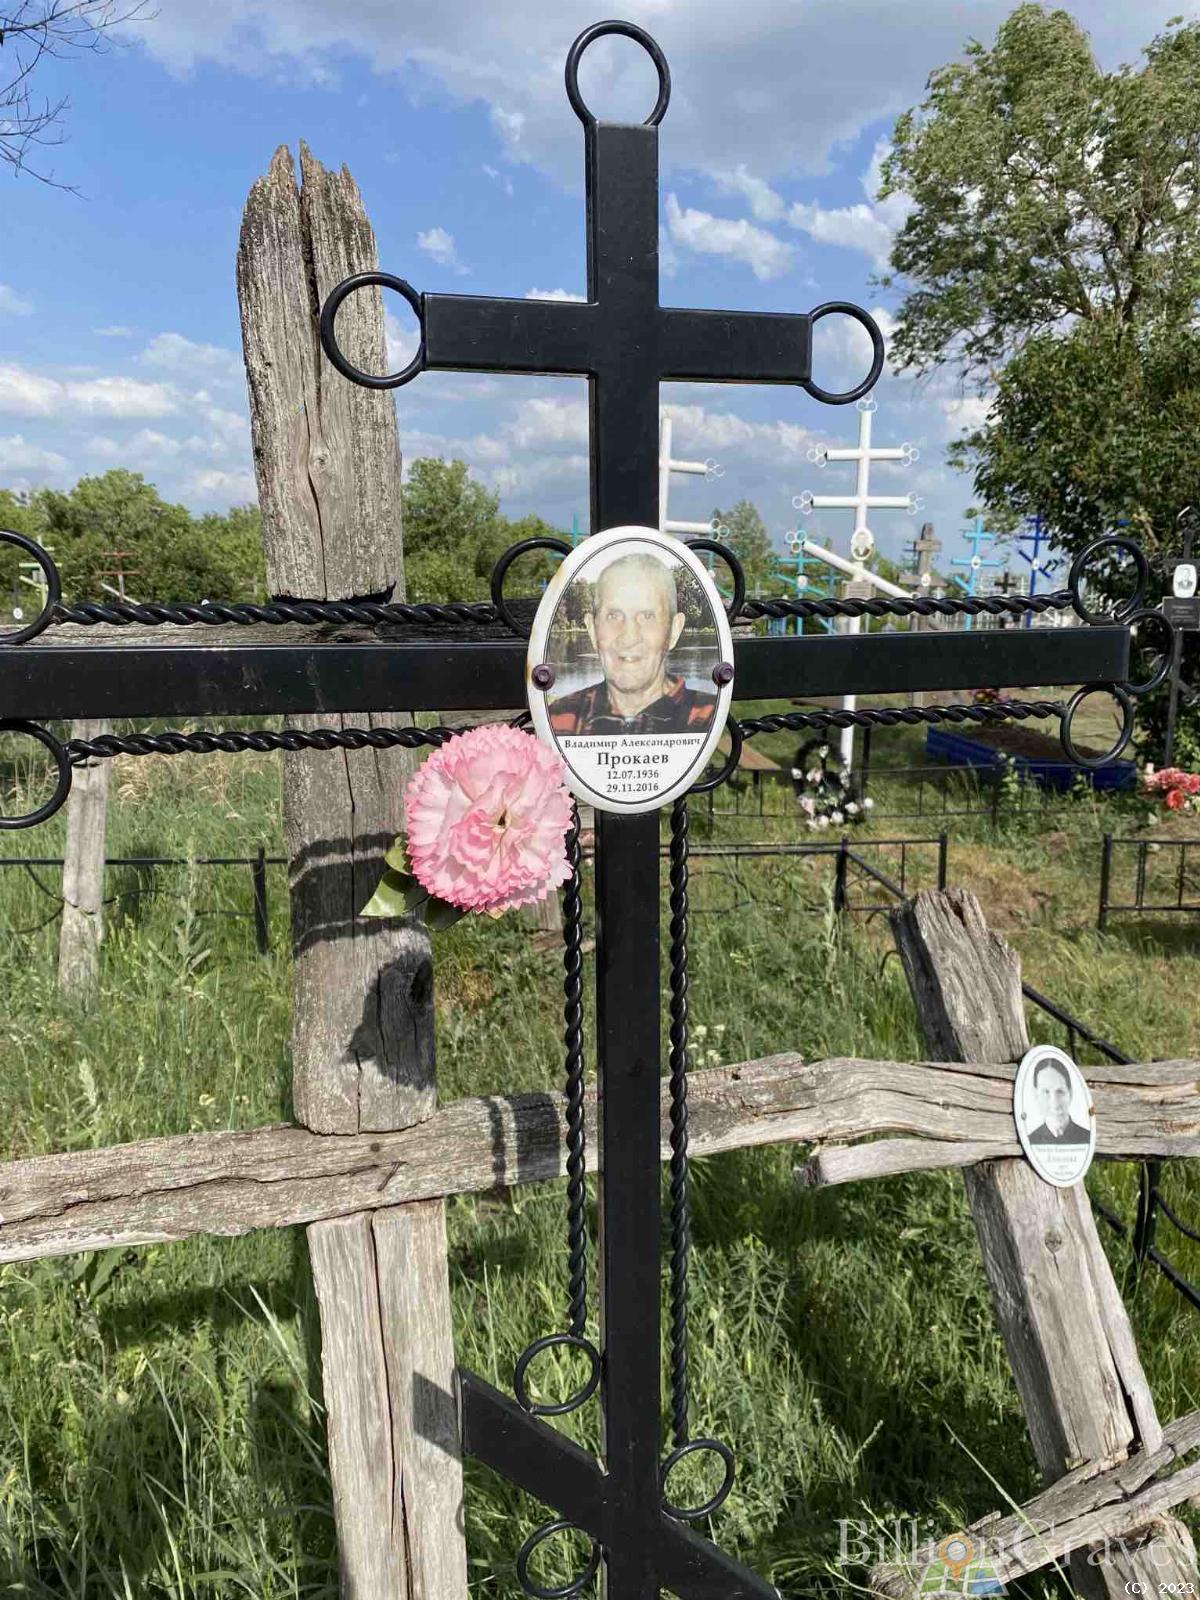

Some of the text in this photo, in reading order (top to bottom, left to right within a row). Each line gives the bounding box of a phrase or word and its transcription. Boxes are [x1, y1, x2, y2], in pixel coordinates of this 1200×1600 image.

[564, 738, 701, 750] Владимир Александрович
[596, 752, 670, 769] Прокаев
[607, 770, 660, 780] 12.07.1936
[606, 783, 660, 793] 29.11.2016
